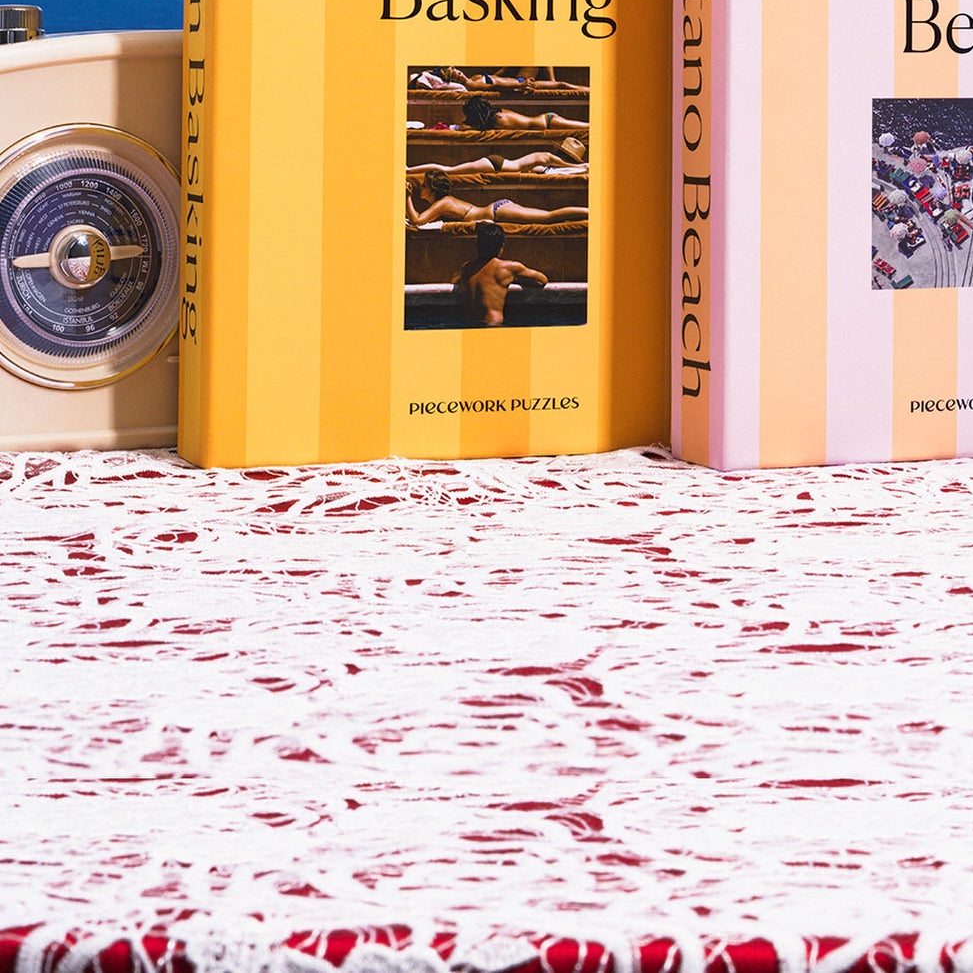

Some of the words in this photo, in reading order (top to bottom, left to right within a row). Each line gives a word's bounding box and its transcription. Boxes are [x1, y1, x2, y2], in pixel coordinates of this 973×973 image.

[56, 181, 73, 191] 1000
[81, 180, 99, 189] 1200
[105, 187, 122, 201] 1400
[130, 209, 143, 227] 1600
[181, 58, 205, 345] Basking
[52, 323, 65, 333] 100
[85, 324, 96, 333] 96
[109, 312, 119, 322] 92
[141, 259, 149, 274] FM
[63, 316, 94, 324] ISTANBUL
[681, 173, 712, 398] Beach
